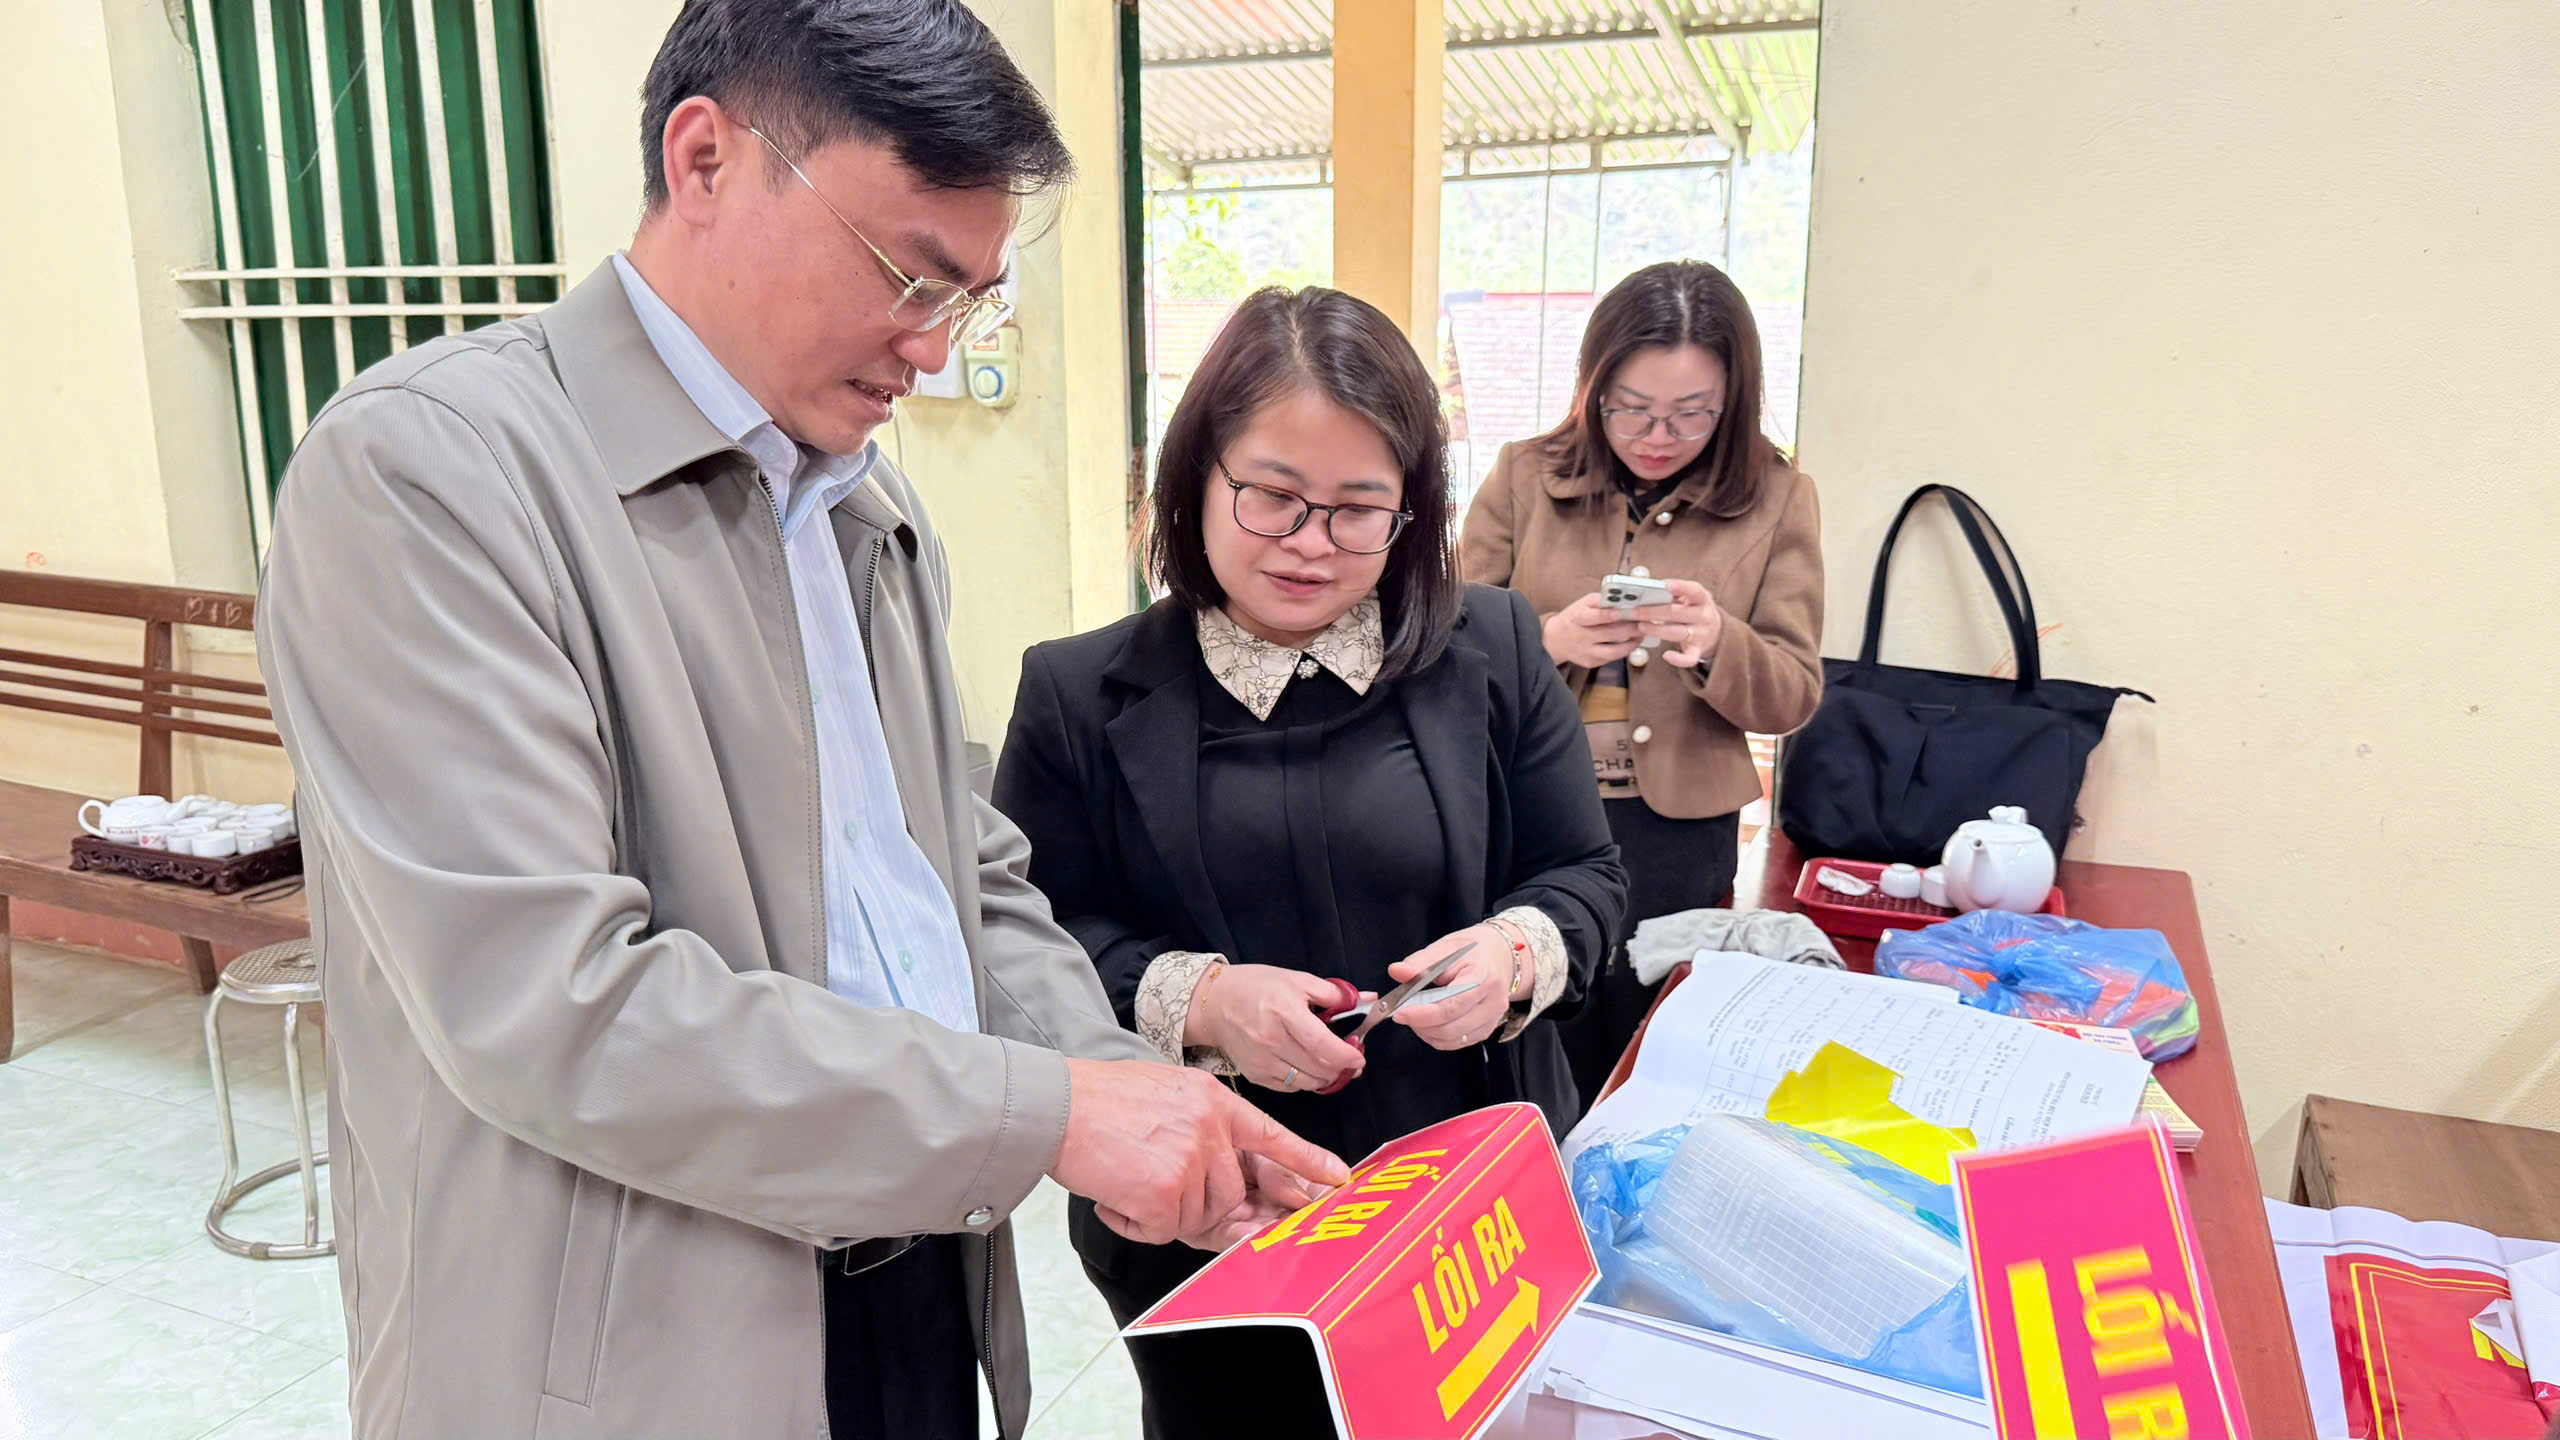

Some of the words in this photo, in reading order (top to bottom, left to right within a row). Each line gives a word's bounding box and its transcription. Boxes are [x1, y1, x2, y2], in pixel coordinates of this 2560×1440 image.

[1353, 1148, 1448, 1194] LỐI
[1295, 1200, 1393, 1246] RA
[1412, 1225, 1480, 1354] LỐI
[1471, 1195, 1526, 1287] RA
[2073, 1244, 2198, 1379] LỐI
